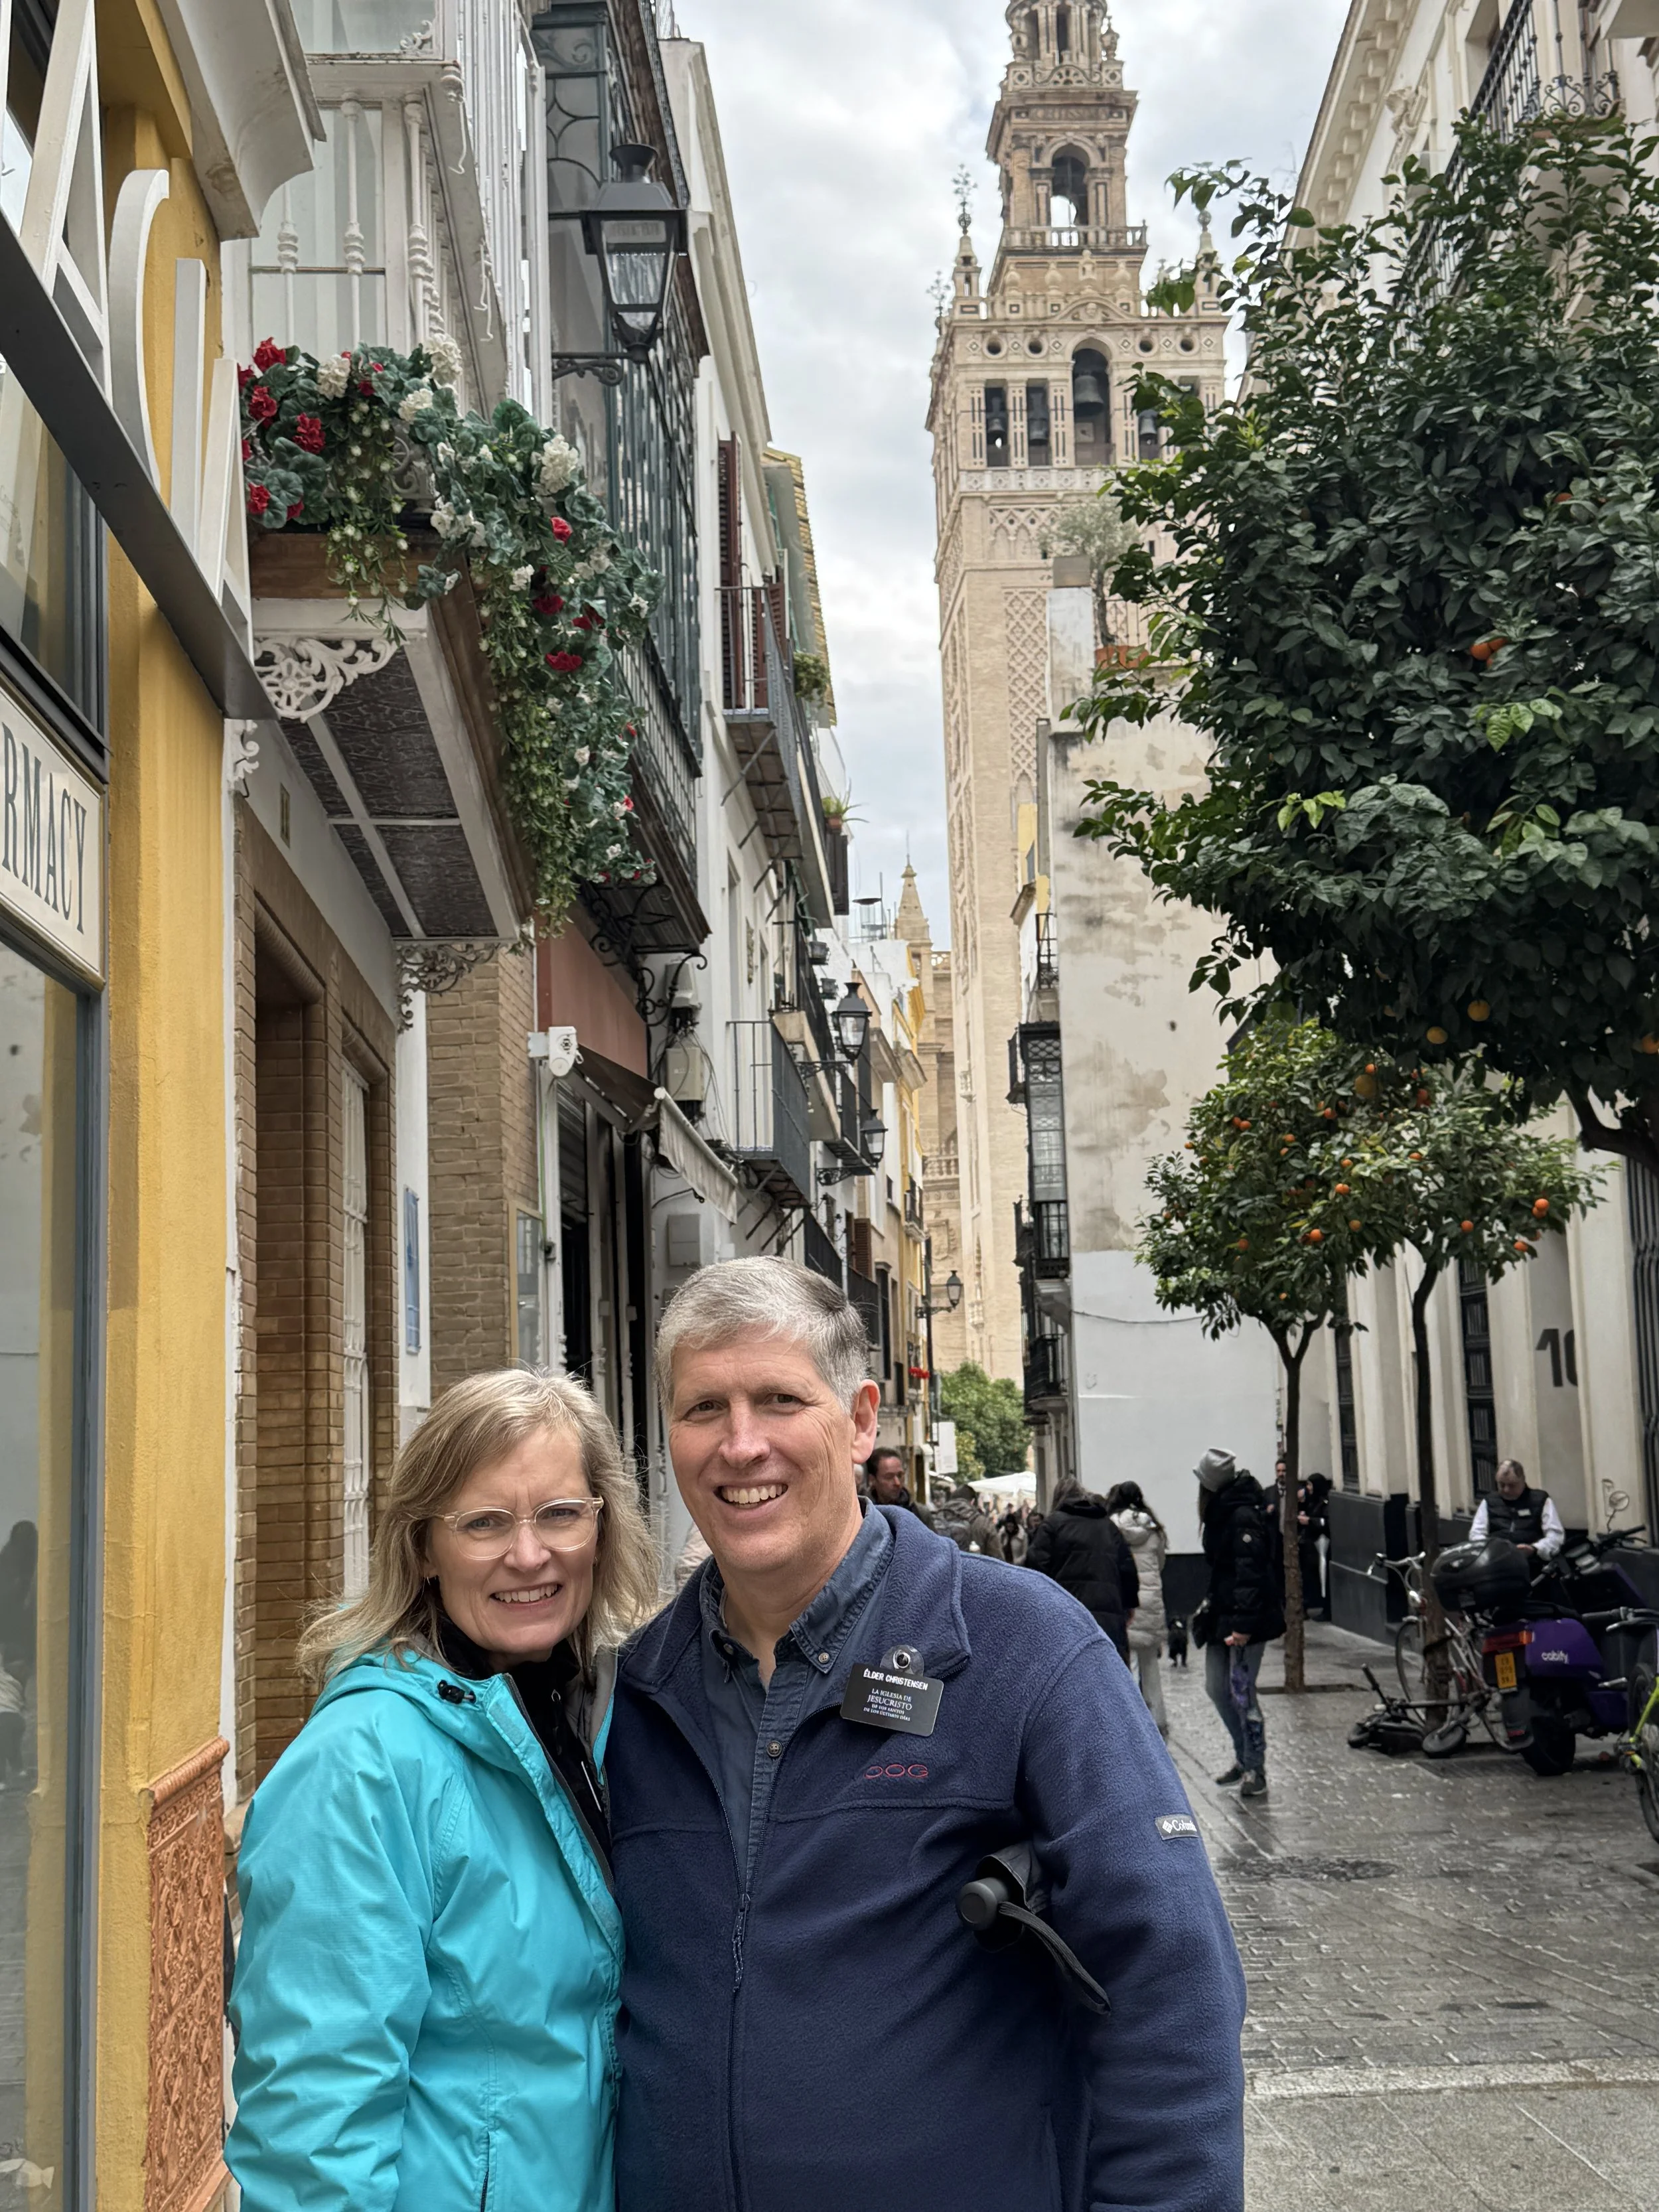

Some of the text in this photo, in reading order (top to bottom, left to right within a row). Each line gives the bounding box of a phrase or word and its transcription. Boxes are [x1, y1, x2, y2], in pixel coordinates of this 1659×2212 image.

[2, 721, 87, 934] RMACY
[1541, 1650, 1569, 1664] cabify
[863, 1668, 928, 1690] ÉLDER CHRISTENSEN
[867, 1694, 912, 1710] JESUCRISTO
[880, 1690, 902, 1700] IGLESIA
